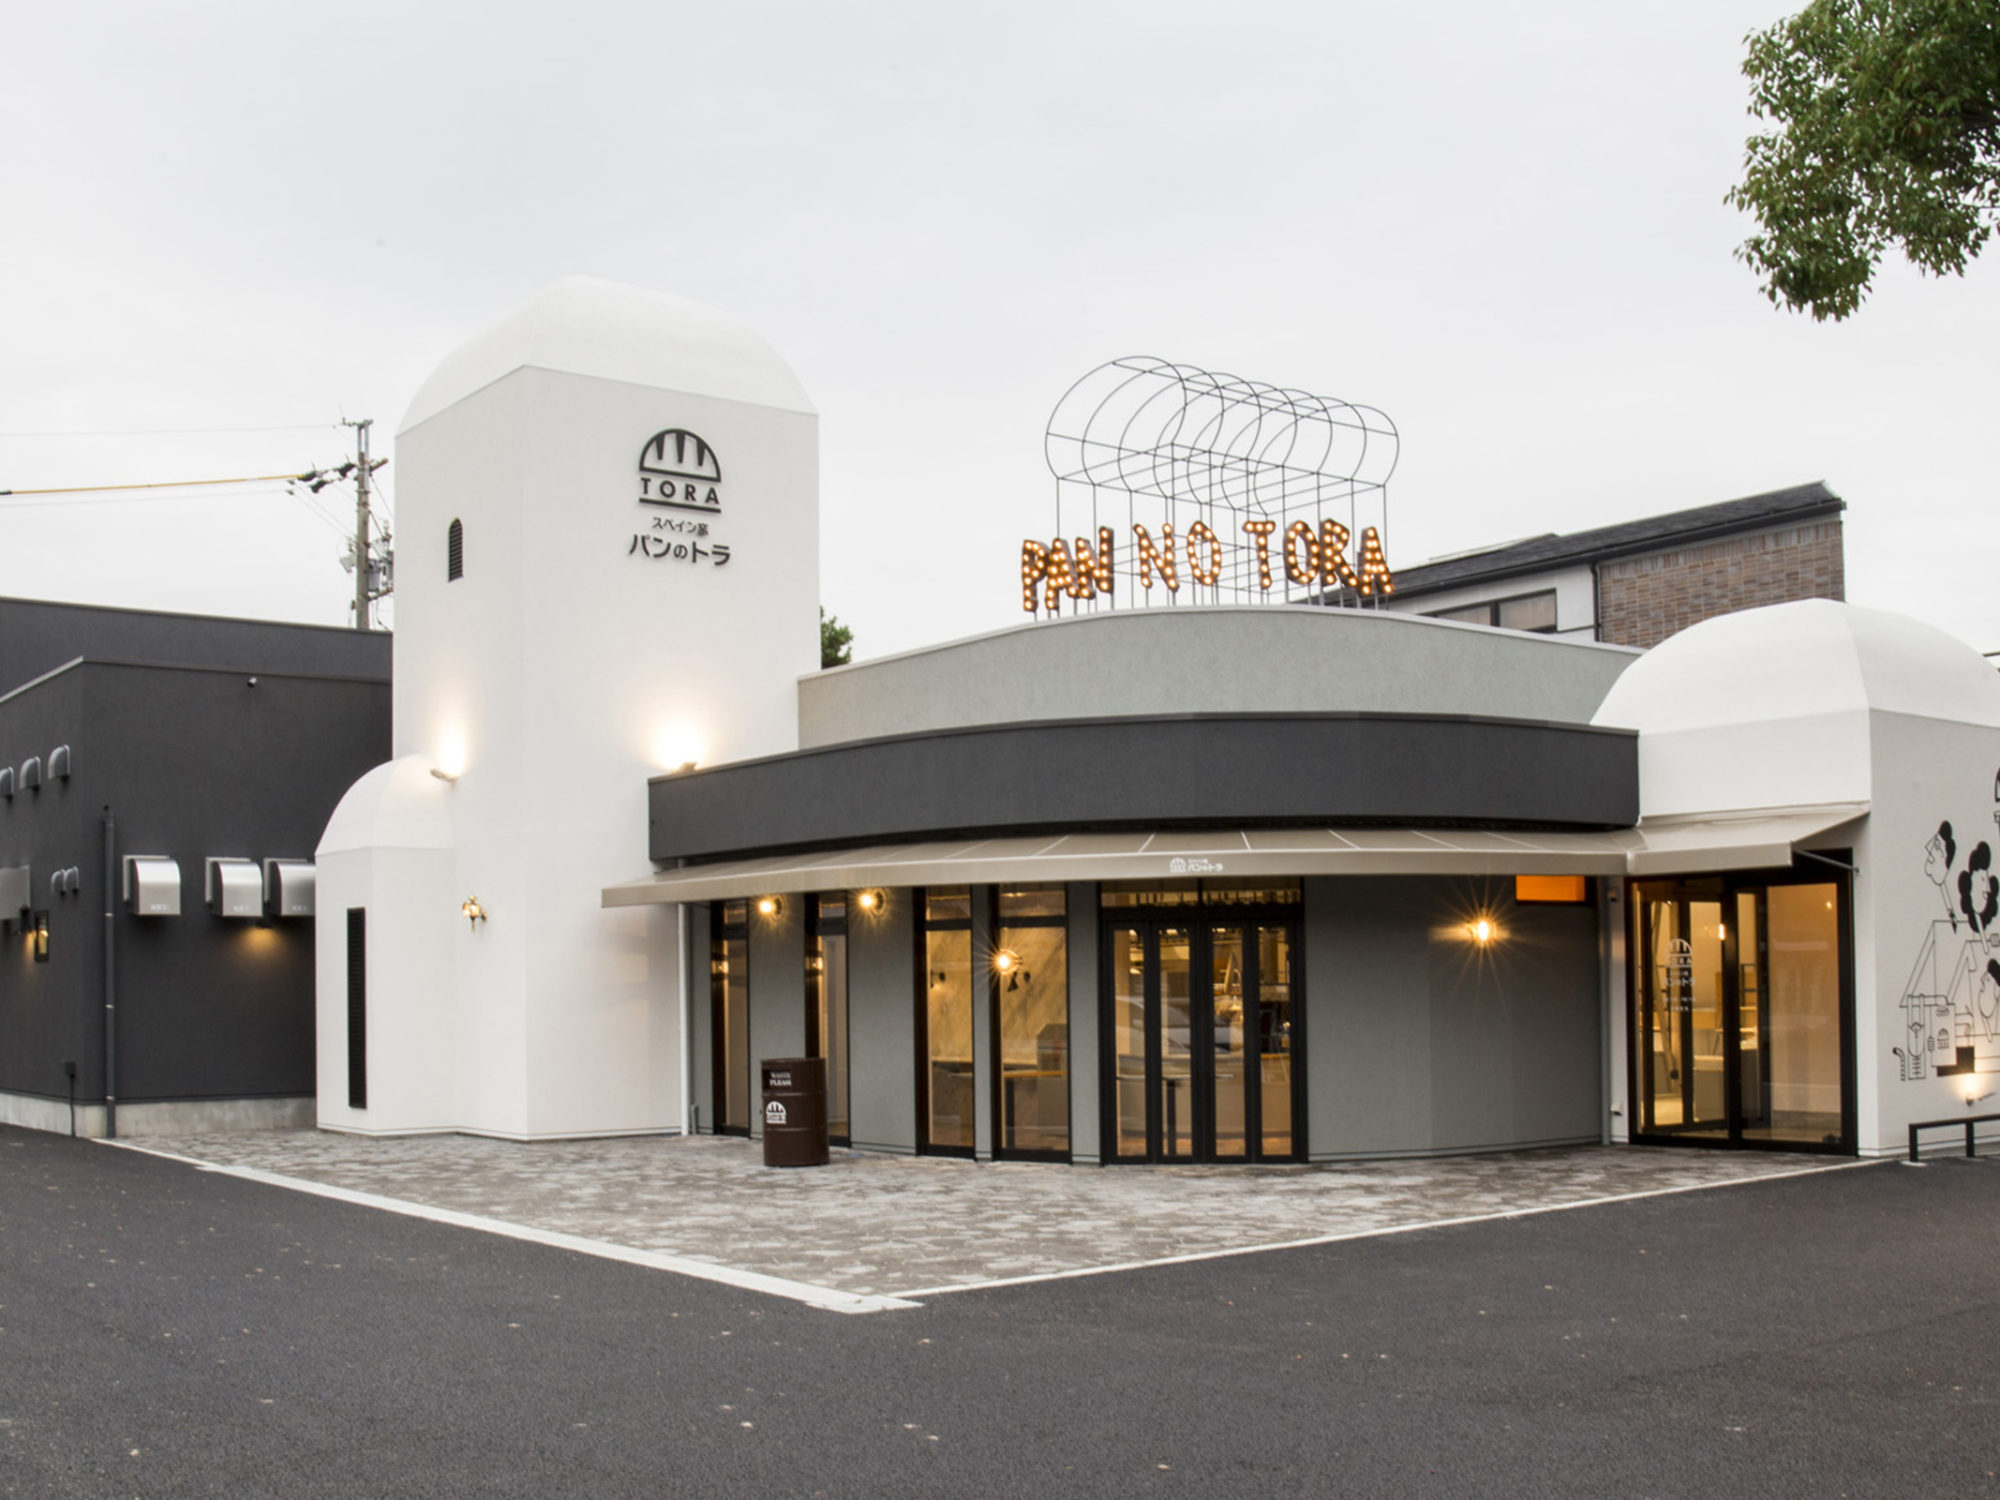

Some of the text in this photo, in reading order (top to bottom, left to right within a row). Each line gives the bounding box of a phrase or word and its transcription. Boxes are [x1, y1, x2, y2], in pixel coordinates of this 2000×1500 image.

[640, 477, 720, 505] TORA
[628, 534, 731, 566] パンのトラ
[1022, 518, 1394, 612] PAN NO TORA
